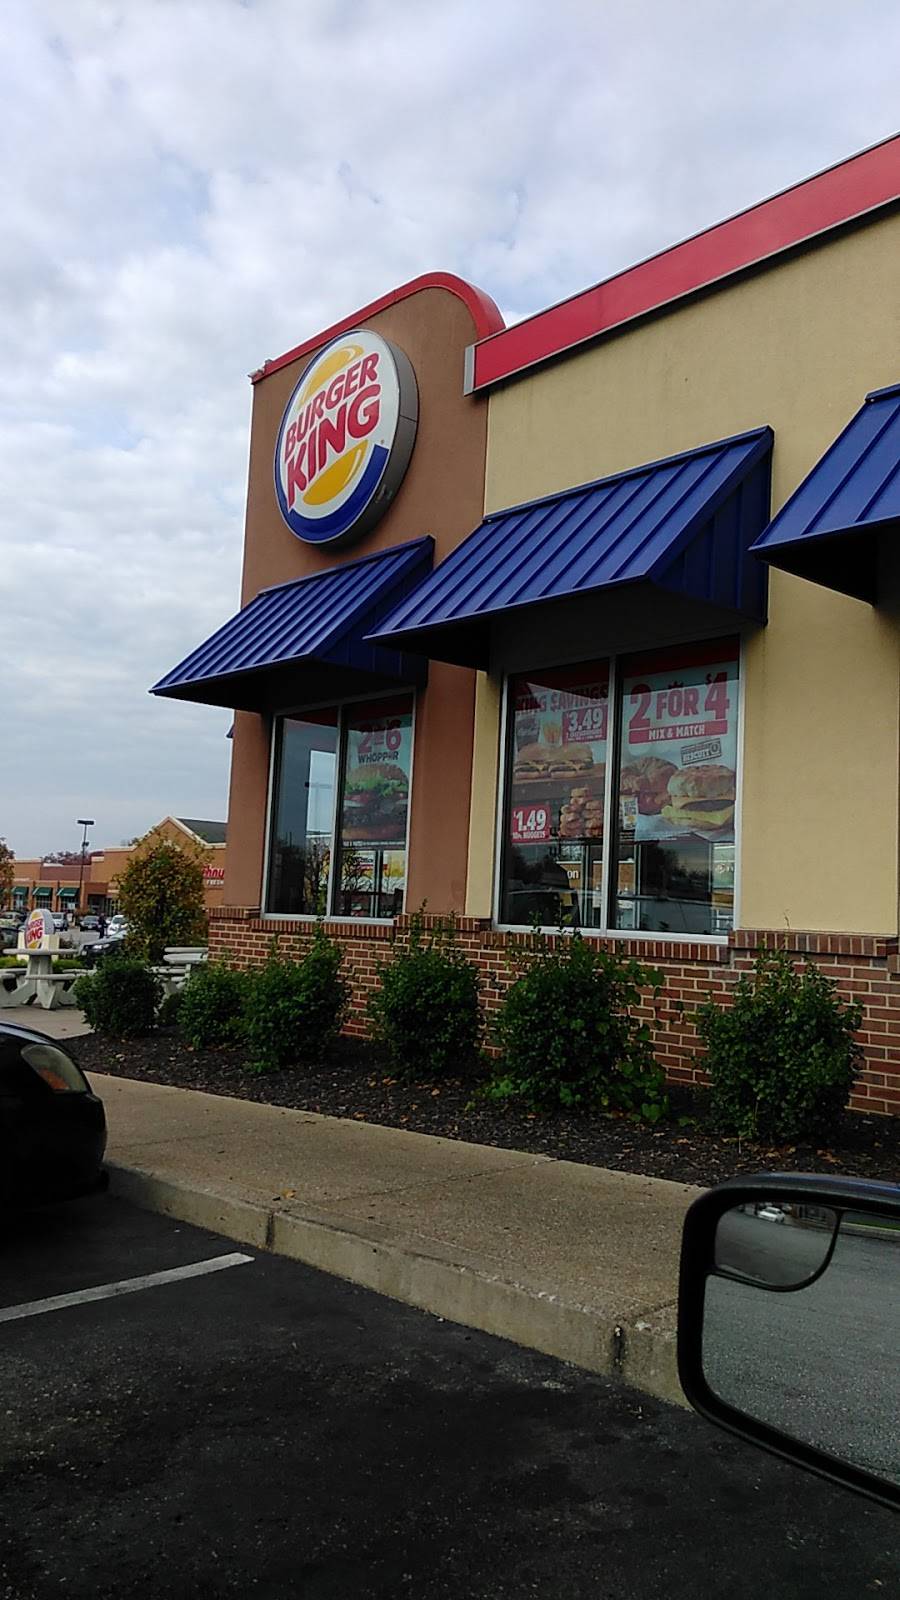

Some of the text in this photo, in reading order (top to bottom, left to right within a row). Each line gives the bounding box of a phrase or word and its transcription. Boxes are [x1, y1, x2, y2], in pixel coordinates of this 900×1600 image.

[285, 352, 380, 463] BURGER
[286, 383, 381, 509] KING
[629, 684, 652, 729] 2
[656, 688, 699, 720] FOR
[648, 724, 705, 740] MIX & MATCH
